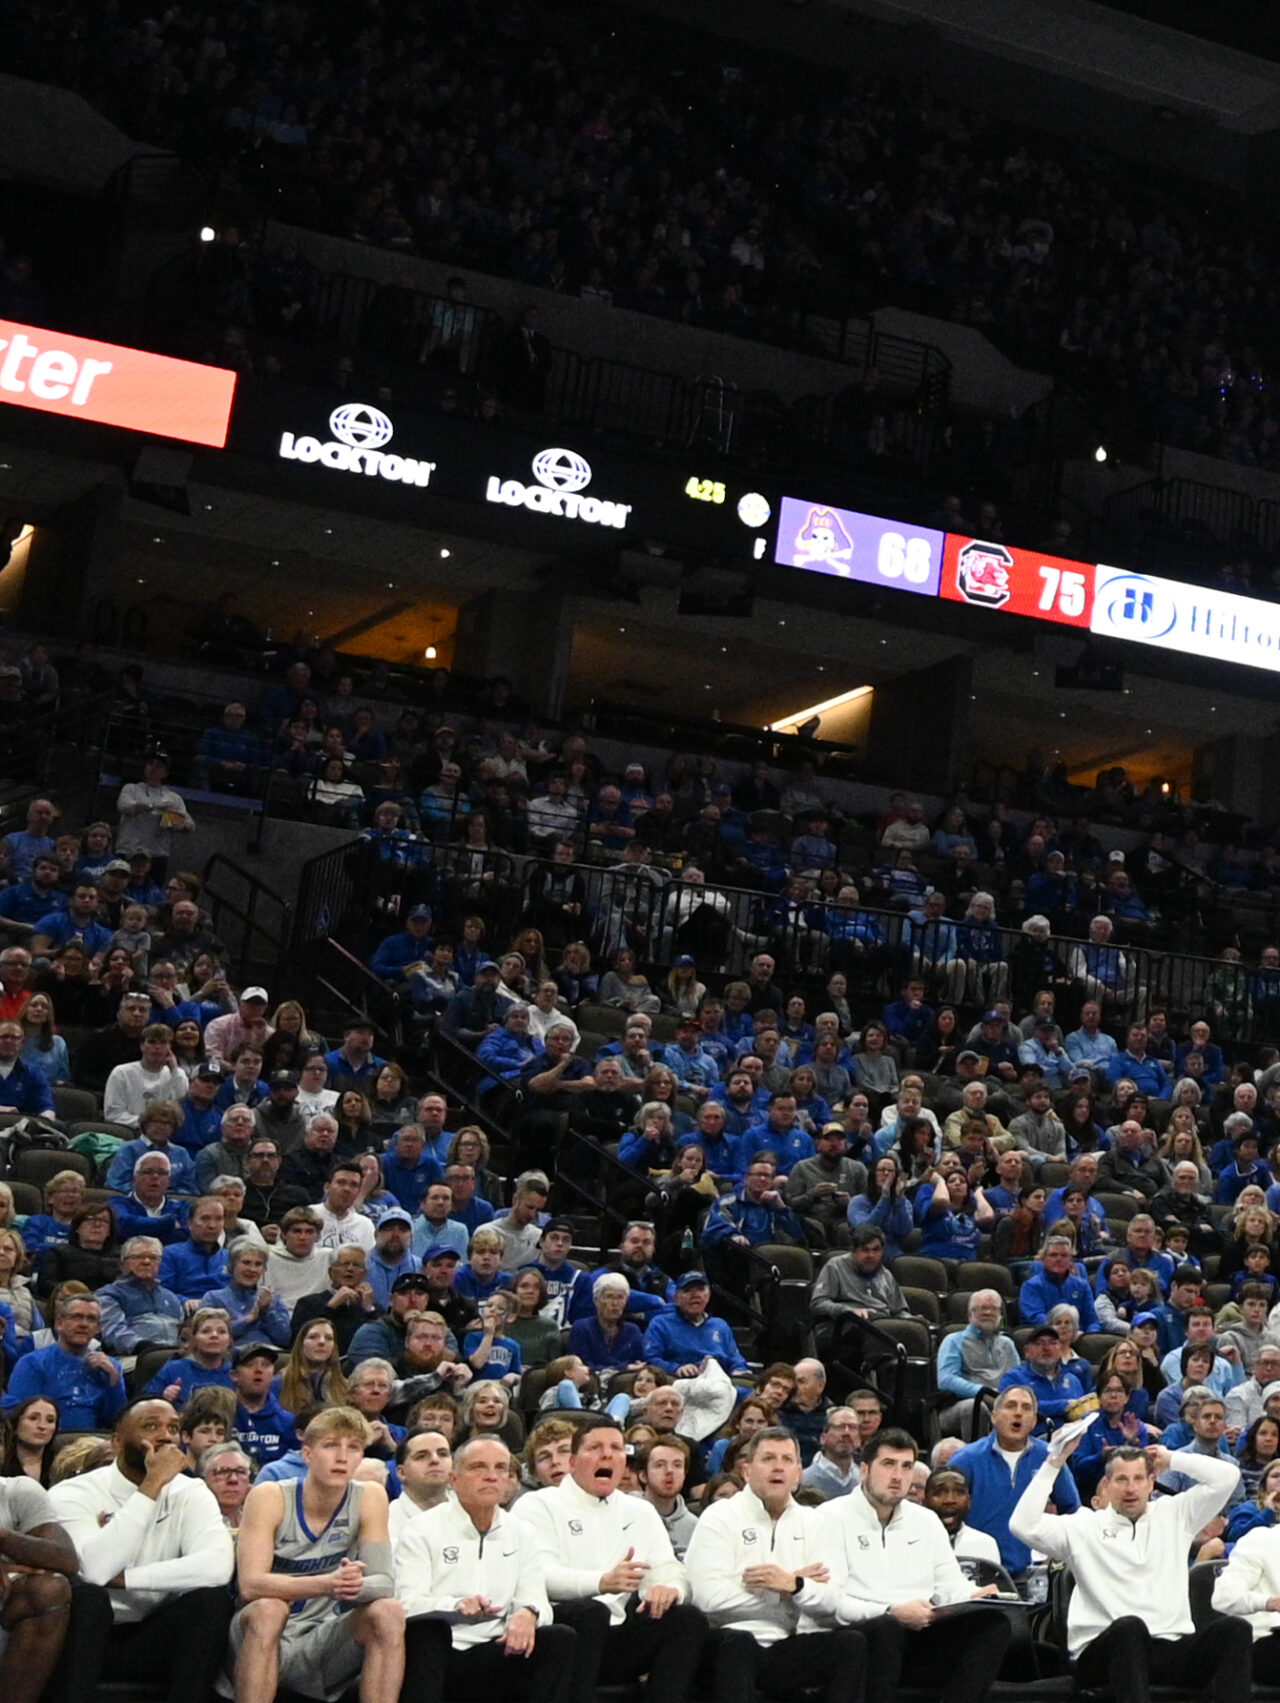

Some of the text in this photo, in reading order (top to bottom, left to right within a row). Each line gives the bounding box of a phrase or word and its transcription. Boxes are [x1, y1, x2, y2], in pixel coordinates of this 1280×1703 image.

[0, 334, 113, 405] ter
[280, 431, 432, 487] LOCKTON
[486, 475, 628, 528] LOCKTON
[877, 532, 932, 584] 68
[1038, 565, 1086, 617] 75
